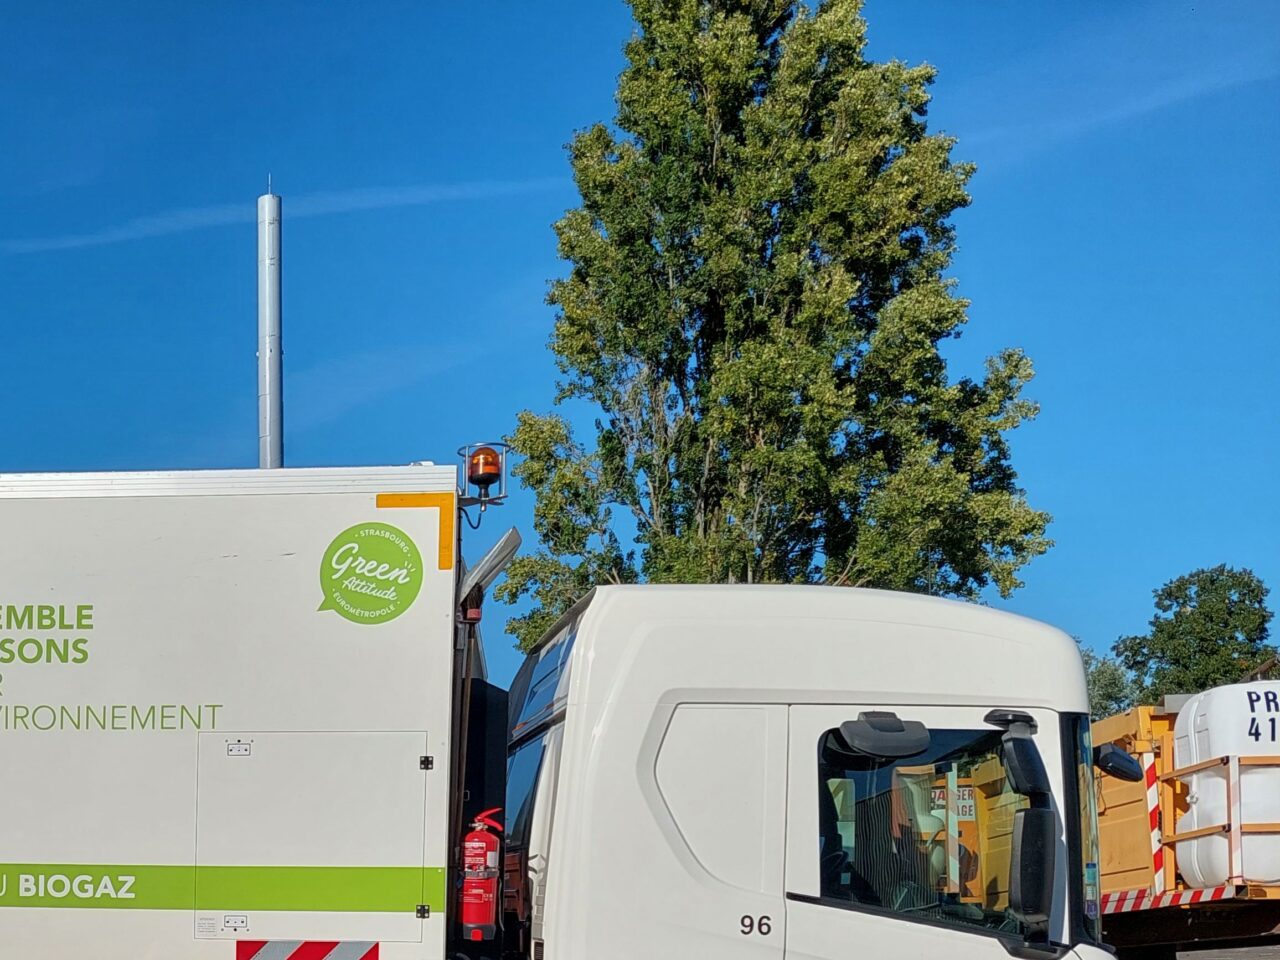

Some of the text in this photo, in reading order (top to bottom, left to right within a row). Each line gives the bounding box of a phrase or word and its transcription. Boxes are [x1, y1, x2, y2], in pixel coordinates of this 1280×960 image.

[359, 528, 410, 553] STRASBOURG
[331, 542, 410, 584] Green
[342, 576, 398, 601] Attitude
[1246, 690, 1280, 713] PR
[19, 874, 136, 899] BIOGAZ
[740, 914, 772, 936] 96
